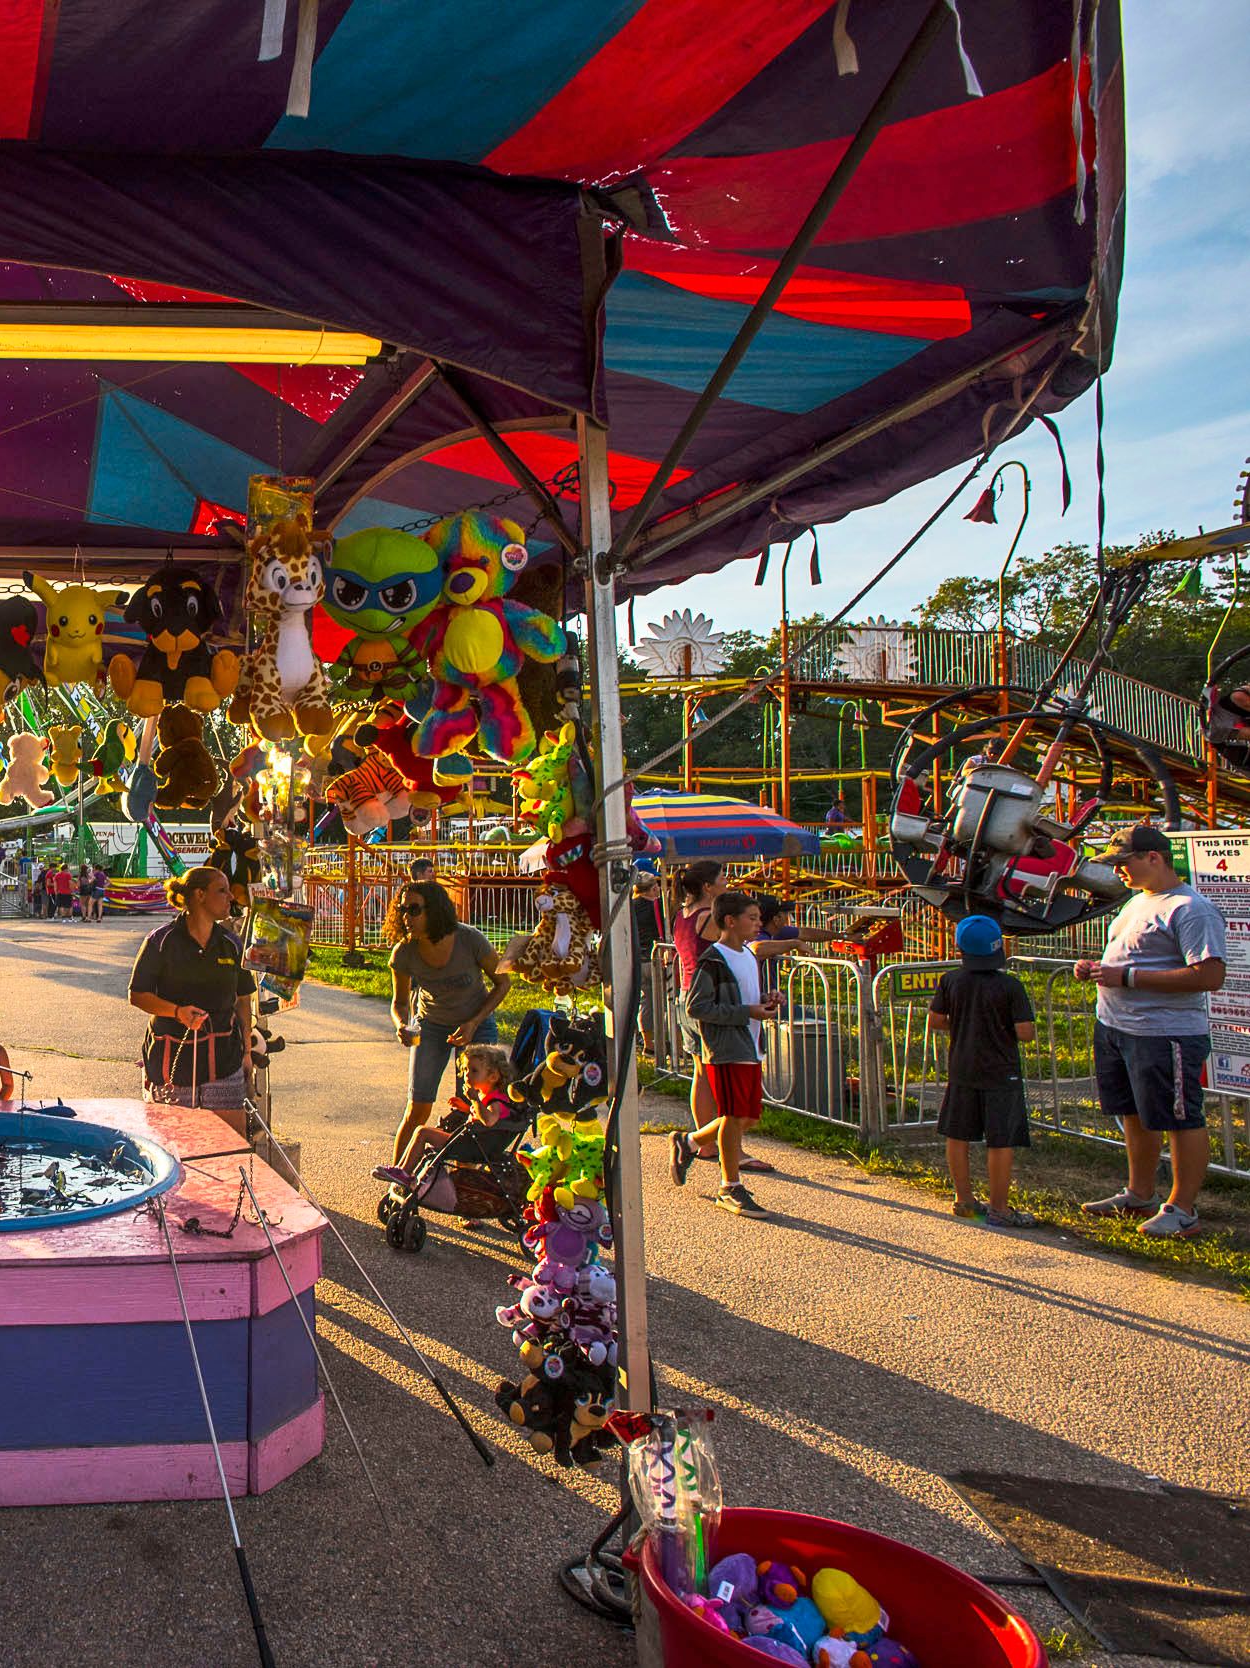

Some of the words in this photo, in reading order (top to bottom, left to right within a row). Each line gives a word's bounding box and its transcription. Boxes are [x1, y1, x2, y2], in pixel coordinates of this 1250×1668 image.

[166, 831, 211, 845] OCKWEL
[1205, 849, 1240, 857] TAKES
[1216, 858, 1228, 872] 4
[1199, 874, 1250, 883] TICKETS
